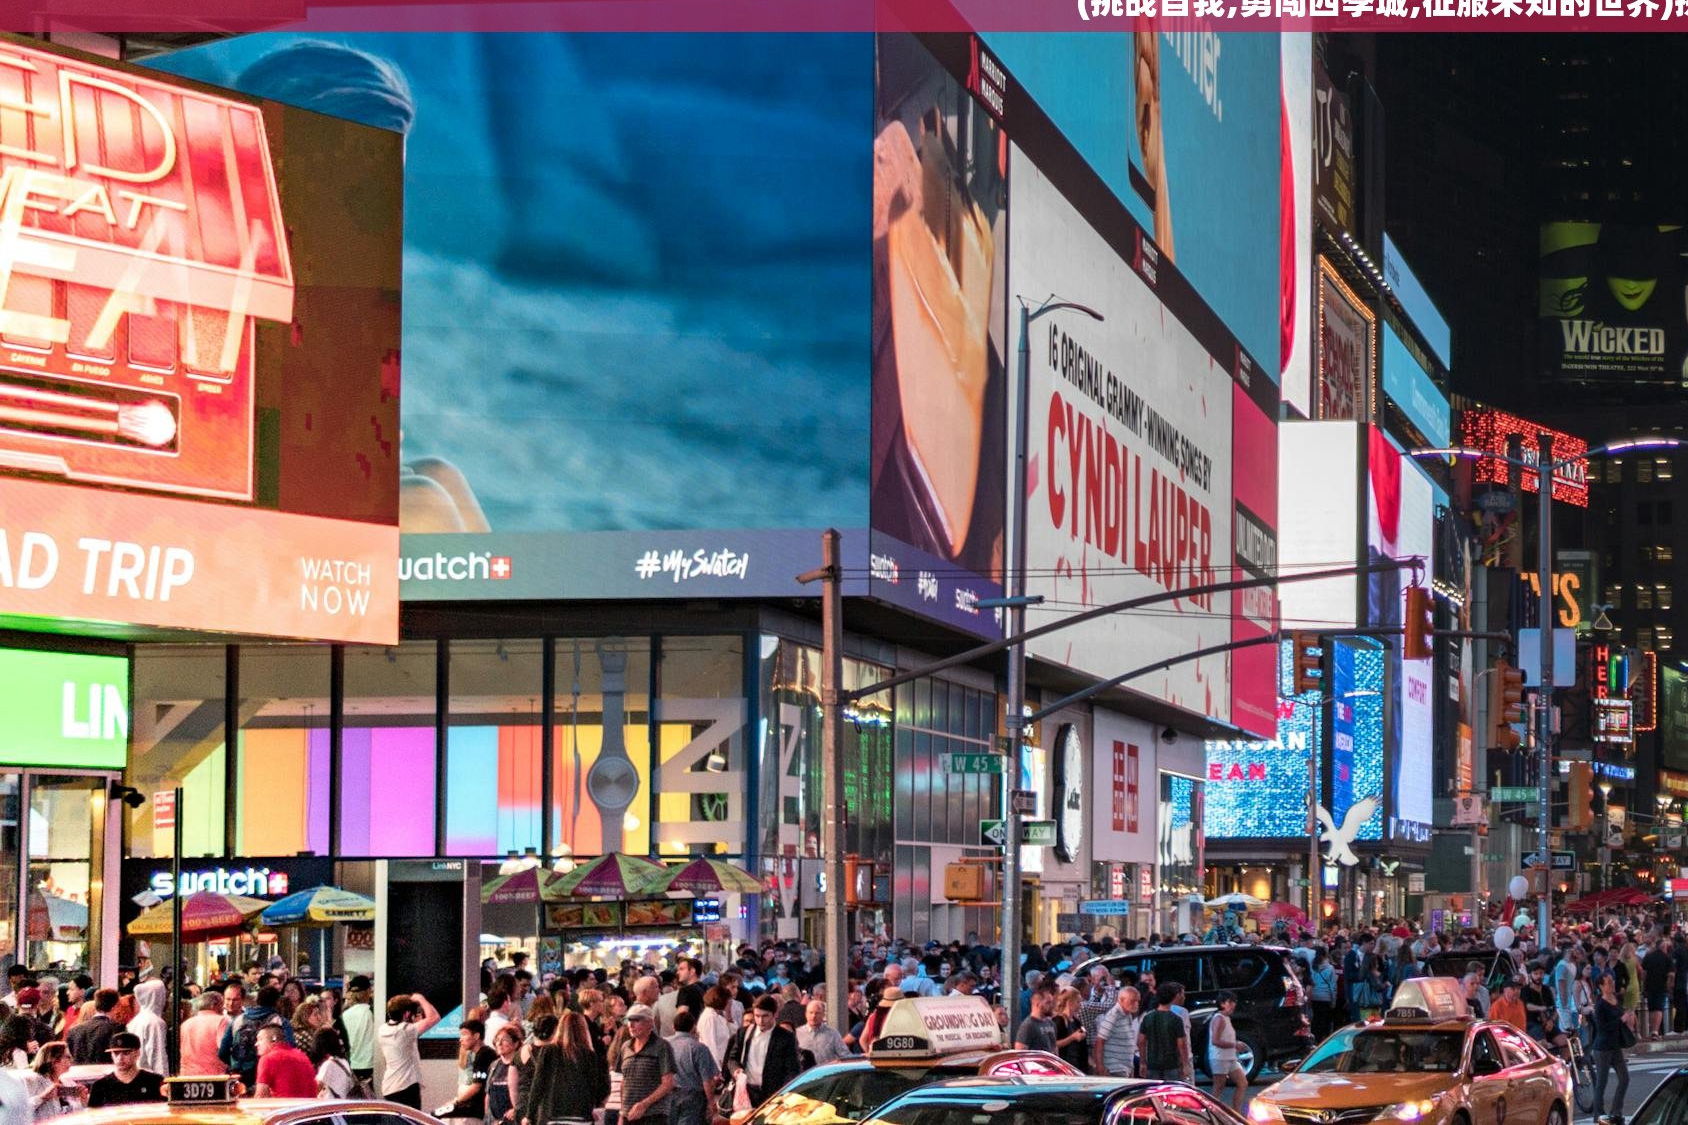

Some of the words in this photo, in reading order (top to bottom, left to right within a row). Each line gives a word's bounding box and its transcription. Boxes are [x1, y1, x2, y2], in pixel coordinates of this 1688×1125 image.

[1048, 320, 1059, 373] 16
[1061, 330, 1105, 410] ORIGINAL
[1180, 433, 1202, 488] SONGS
[1203, 454, 1213, 496] BY
[1047, 389, 1129, 566] CYNDI
[1134, 452, 1216, 614] LAUPER
[78, 538, 196, 603] TRIP
[301, 557, 372, 587] WATCH
[300, 588, 372, 617] NOW
[955, 756, 967, 772] W
[972, 755, 988, 772] 45
[1516, 791, 1528, 801] 45
[432, 861, 462, 871] LinkNYC
[979, 1012, 995, 1028] DAY
[886, 1037, 915, 1049] 9G80
[183, 1082, 215, 1099] 3D79
